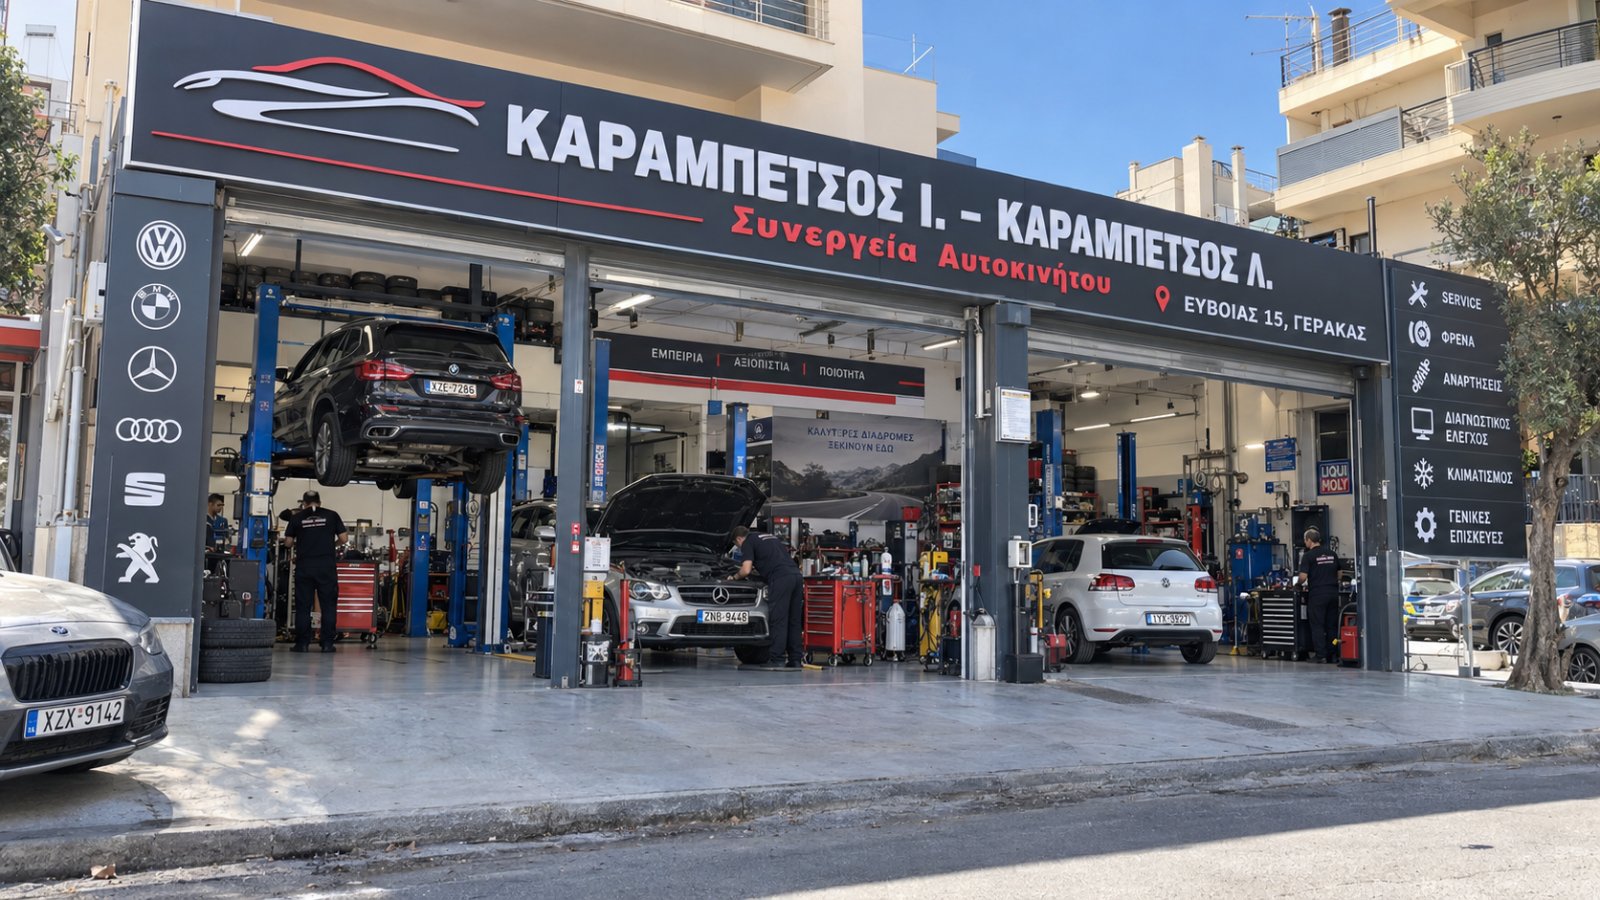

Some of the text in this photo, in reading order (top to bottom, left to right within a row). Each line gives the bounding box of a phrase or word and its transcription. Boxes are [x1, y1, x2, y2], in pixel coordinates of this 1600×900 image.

[506, 103, 903, 224] ΚΑΡΑΜΠΕΤΣΟΣ
[997, 198, 1238, 284] ΚΑΡΑΜΠΕΤΣΟΣ
[1246, 252, 1273, 290] Λ.
[730, 205, 1111, 295] Συνεργεία Αυτοκινήτου
[1442, 291, 1482, 310] SERVICE
[1184, 296, 1367, 342] ΕΥΒΟΙΑΣ 15, ΓΕΡΑΚΑΣ
[1441, 330, 1476, 348] ΦΡΕΝΑ
[651, 348, 865, 381] ΕΜΠΕΙΡΙΑ ΑΞΙΟΠΙΣΤΙΑ ΠΟΙΟΤΗΤΑ
[1443, 372, 1503, 393] ΑΝΑΡΤΗΣΕΙΣ
[1445, 411, 1511, 430] ΔΙΑΓΝΩΣΤΙΚΟΣ
[861, 430, 914, 442] ΔΙΑΔΡΟΜΕΣ
[1446, 429, 1488, 446] ΕΛΕΓΧΟΣ
[828, 440, 894, 453] ΞΕΚΙΝΟΥΝ ΕΔΩ
[1321, 464, 1348, 478] LIQUI
[1447, 467, 1513, 484] ΚΛΙΜΑΤΙΣΜΟΣ
[1321, 478, 1348, 491] MOLY
[1449, 509, 1491, 524] ΓΕΝΙΚΕΣ
[1450, 529, 1504, 545] ΕΠΙΣΚΕΥΕΣ
[43, 701, 122, 732] XZX-9142
